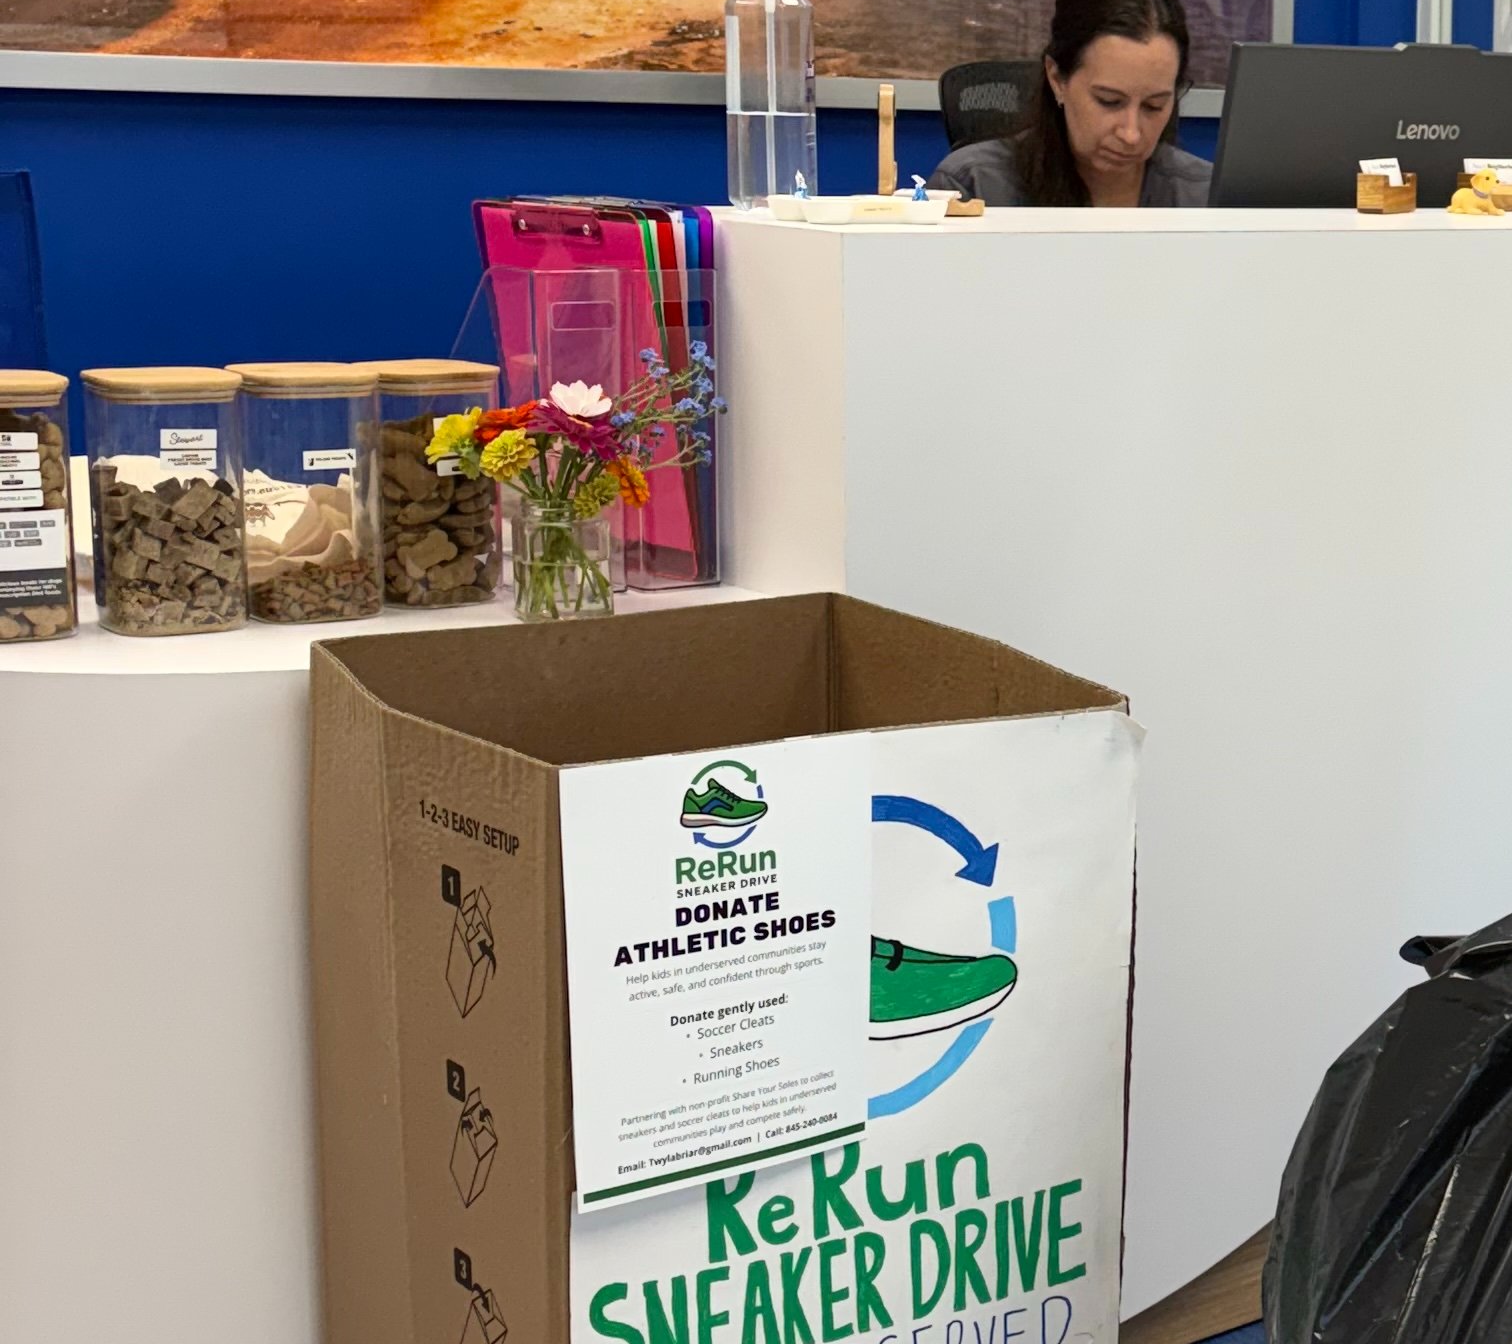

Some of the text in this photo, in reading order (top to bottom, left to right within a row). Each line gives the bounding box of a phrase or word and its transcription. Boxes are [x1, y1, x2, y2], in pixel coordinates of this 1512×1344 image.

[1396, 120, 1460, 141] Lenovo
[419, 799, 519, 856] 1-2-3 EASY SETUP
[674, 848, 777, 885] ReRun
[448, 876, 454, 896] 1
[676, 874, 778, 899] SNEAKER DRIVE
[674, 891, 781, 927] DONATE
[613, 909, 837, 967] ATHLETIC SHOES
[626, 940, 827, 985] Help kids in underserved communities stay
[628, 955, 824, 1002] active, safe, and confident through sports.
[670, 993, 789, 1027] Donate gently used:
[697, 1012, 775, 1041] Soccer Cleats
[709, 1036, 764, 1060] Sneakers
[452, 1069, 461, 1092] 2
[693, 1057, 780, 1084] Running Shoes
[618, 1082, 837, 1142] sneakers and soccer cleats to help kids in underserved
[621, 1109, 667, 1126] Partnering
[668, 1105, 687, 1116] with
[732, 1089, 756, 1102] Share
[801, 1076, 809, 1085] to
[810, 1070, 834, 1083] collect
[653, 1130, 708, 1148] communities
[709, 1125, 727, 1137] play
[729, 1120, 744, 1130] and
[746, 1112, 781, 1128] compete
[618, 1159, 647, 1175] Email:
[765, 1126, 784, 1139] Call:
[909, 1178, 1087, 1321] DRIVE
[459, 1259, 468, 1281] 3
